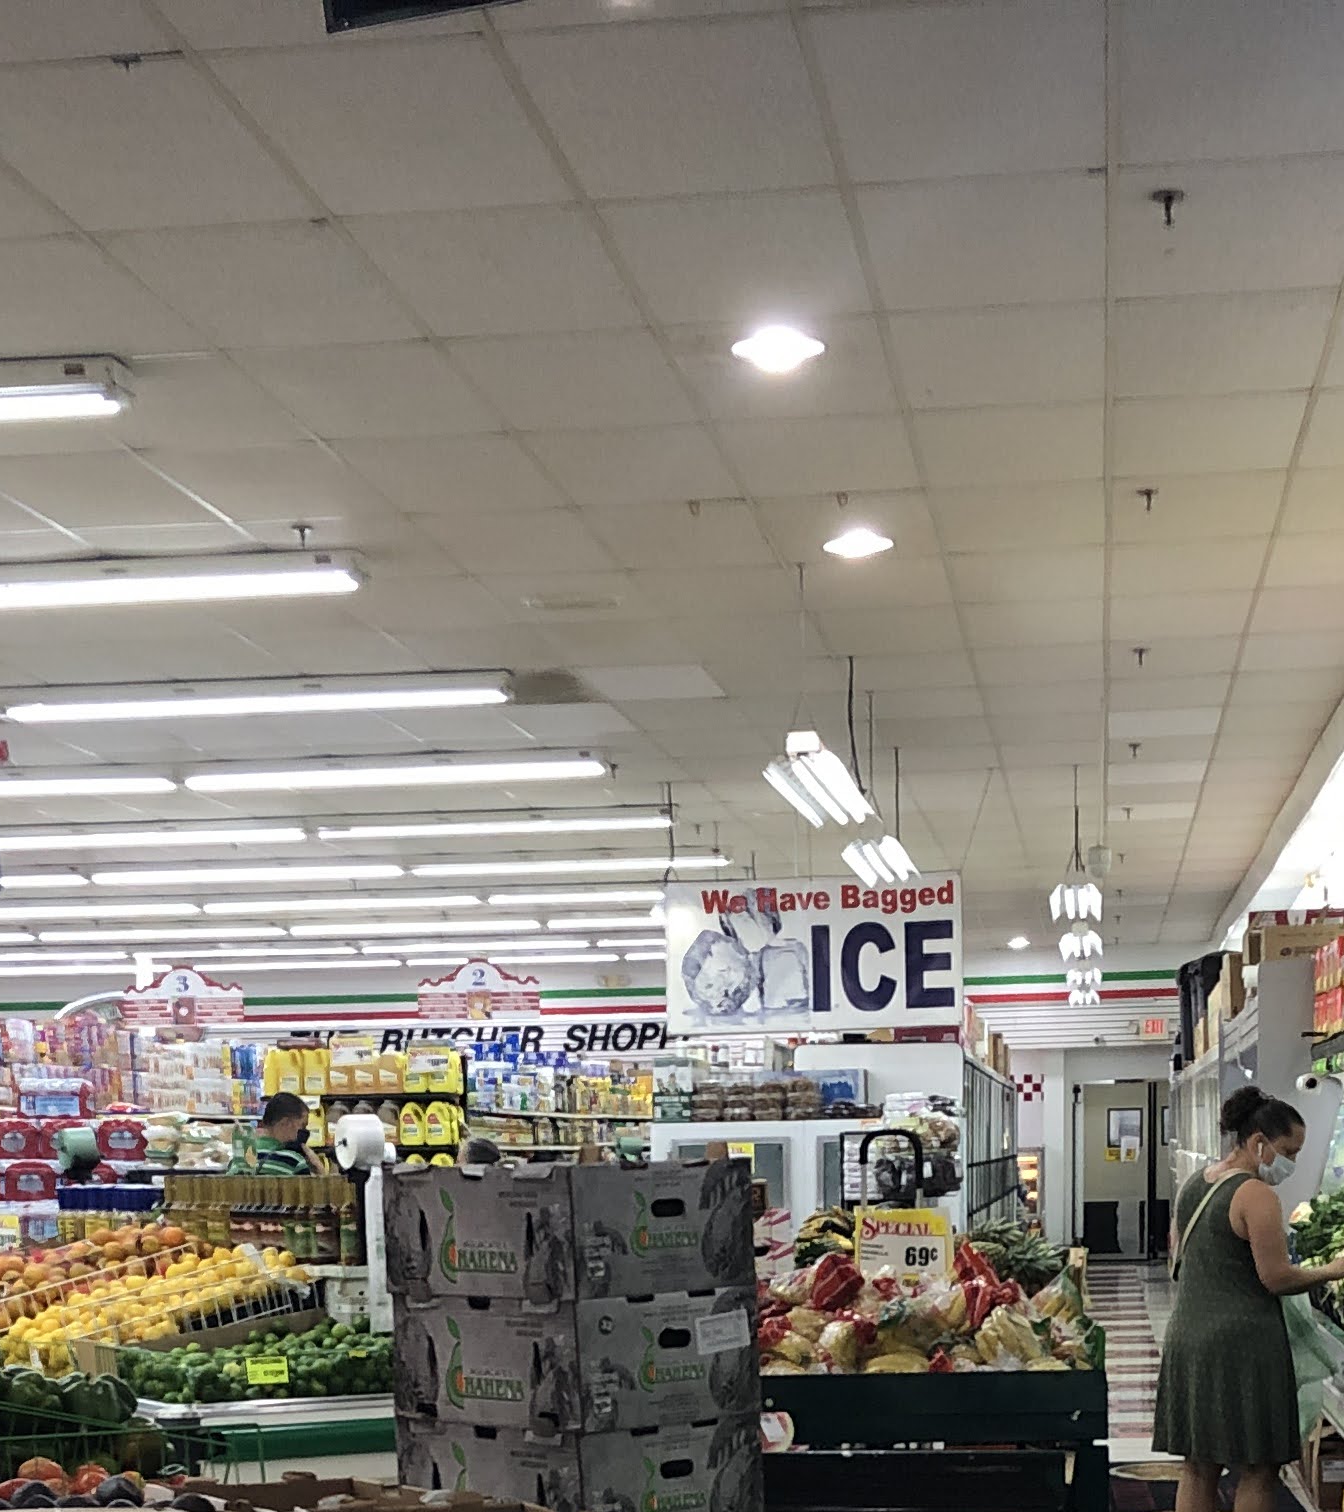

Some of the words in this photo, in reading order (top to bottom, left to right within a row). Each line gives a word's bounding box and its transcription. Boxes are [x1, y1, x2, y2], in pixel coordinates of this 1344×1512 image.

[702, 889, 747, 914] We
[757, 887, 830, 912] Have
[840, 880, 954, 914] Bagged
[471, 969, 486, 986] 2
[811, 919, 955, 1013] ICE
[176, 977, 190, 993] 3
[563, 1022, 669, 1052] SHOP
